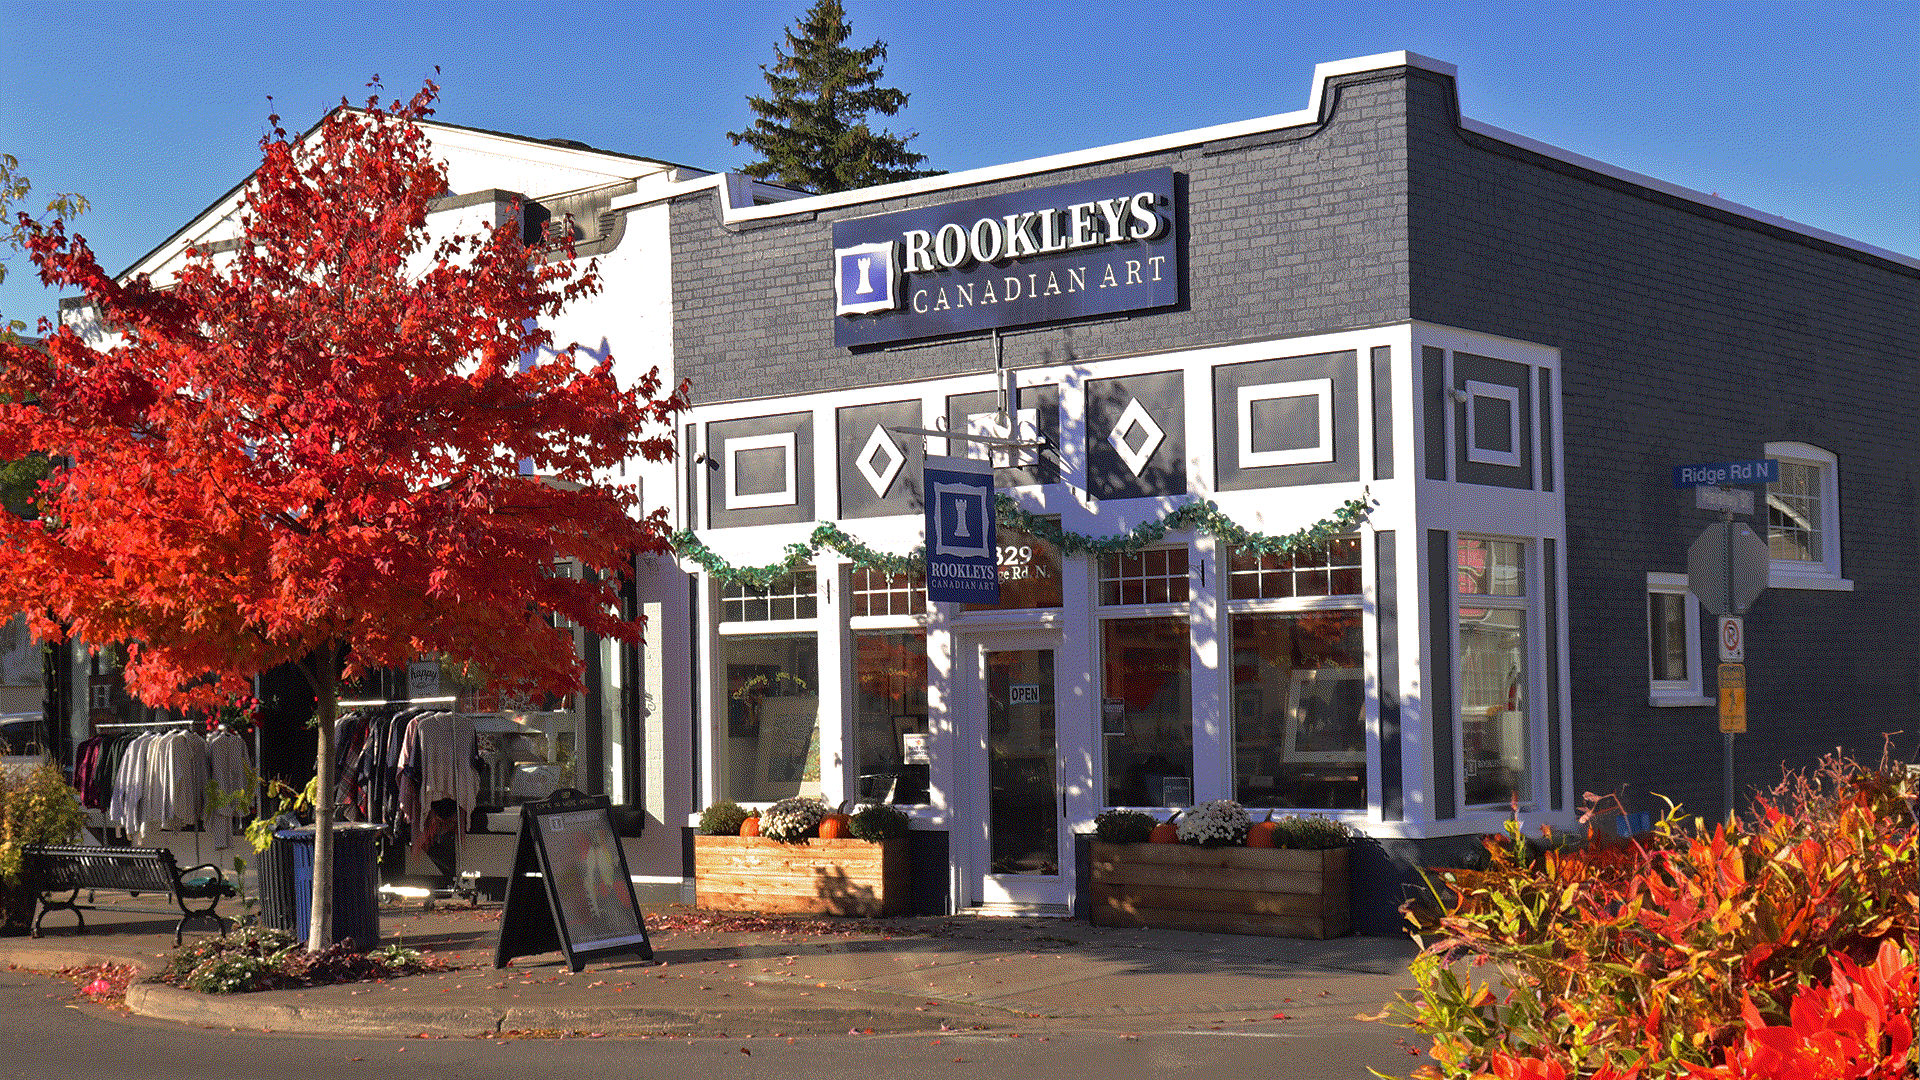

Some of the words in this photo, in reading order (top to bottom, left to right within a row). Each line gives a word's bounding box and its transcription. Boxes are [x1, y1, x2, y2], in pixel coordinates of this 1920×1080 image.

[903, 192, 1160, 273] ROOKLEYS
[913, 267, 1087, 313] CANADIAN
[1099, 256, 1166, 288] ART
[1682, 467, 1726, 485] Ridge
[1730, 463, 1752, 481] Rd
[1755, 462, 1769, 480] N
[931, 562, 995, 580] ROOKLEYS
[932, 579, 976, 590] CANADIAN
[977, 580, 995, 591] ART
[410, 667, 438, 682] happy
[1011, 687, 1038, 701] OPEN
